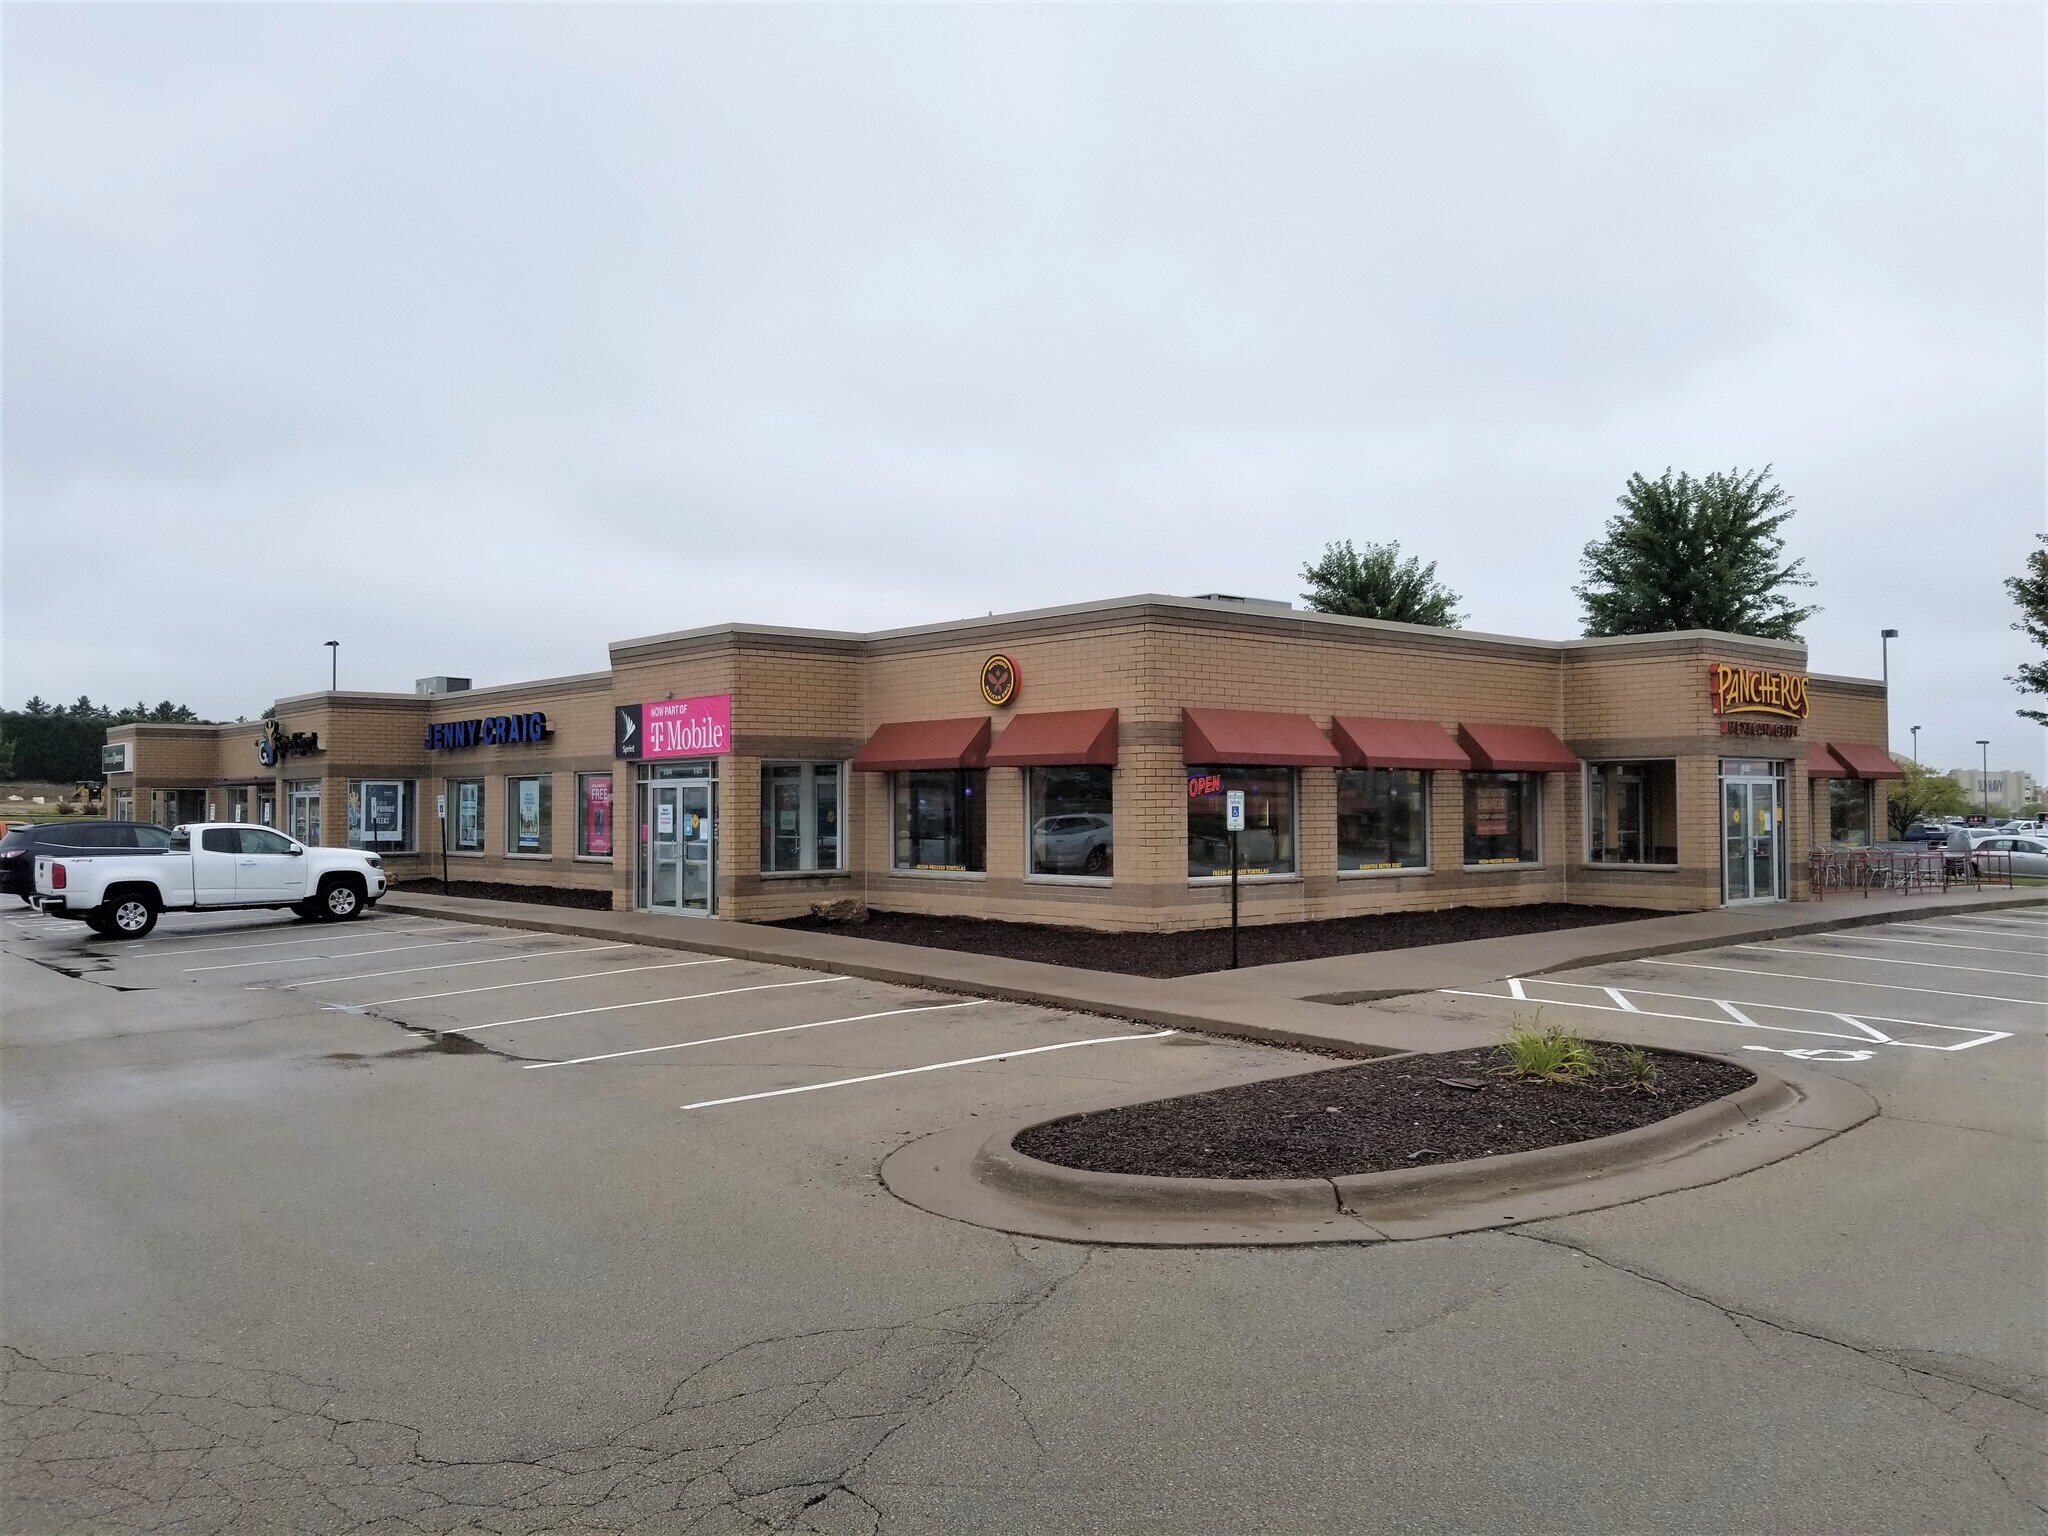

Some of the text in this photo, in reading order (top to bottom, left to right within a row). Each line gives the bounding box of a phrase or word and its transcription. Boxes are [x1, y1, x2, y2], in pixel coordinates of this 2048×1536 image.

[1717, 662, 1810, 719] PANCHEROS
[650, 704, 688, 717] NOW PART OF
[424, 711, 543, 750] JENNY CRAIG
[622, 744, 636, 755] Sprint
[591, 789, 608, 800] FREE
[1189, 774, 1221, 797] OPEN
